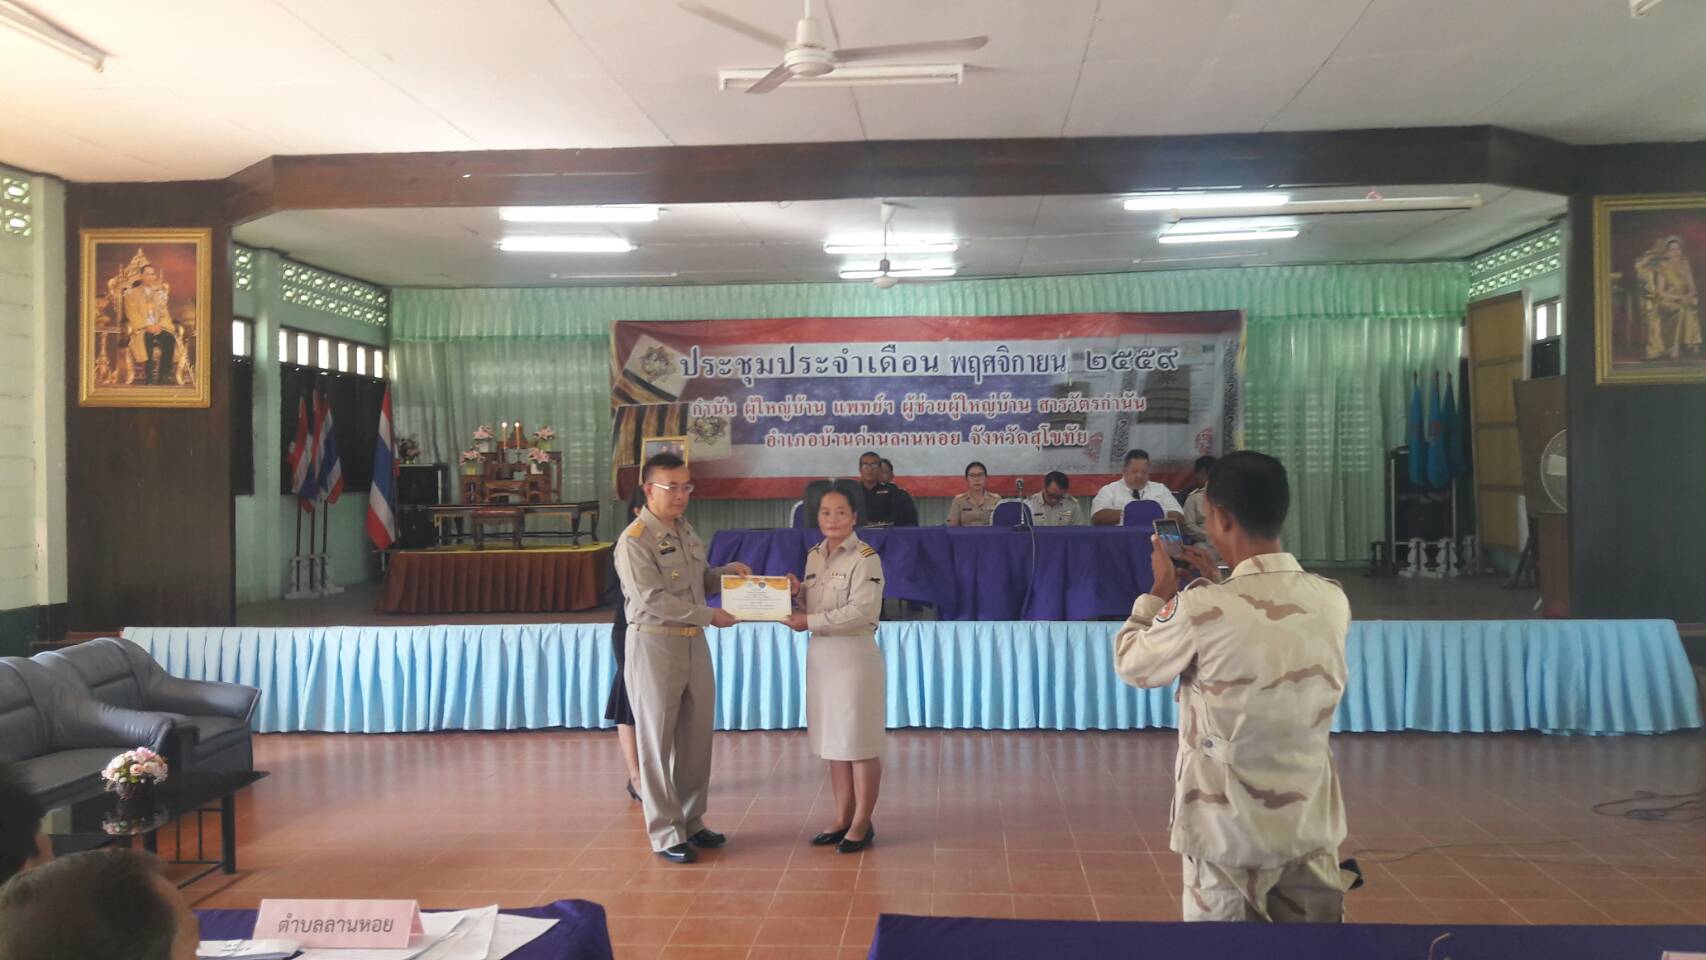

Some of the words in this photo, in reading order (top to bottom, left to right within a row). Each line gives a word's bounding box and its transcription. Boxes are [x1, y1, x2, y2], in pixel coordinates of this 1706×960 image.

[680, 344, 938, 385] ประชุมประจำเดือน
[949, 344, 1067, 383] พฤศจิกายน
[1086, 347, 1180, 371] ๒๕๕๙
[691, 397, 736, 417] กำนัน
[744, 395, 826, 421] ผู้ใหญ่บ้าน
[833, 393, 894, 415] แพทย์ฯ
[901, 392, 1030, 420] ผู้ช่วยผู้ใหญ่บ้าน
[1039, 390, 1146, 413] สารวัตรกำนัน
[765, 425, 962, 448] อำเภอบ้านด่านลานหอย
[969, 425, 1089, 450] จังหวัดสุโขทัย
[277, 911, 394, 934] ตำบลลานหอย
